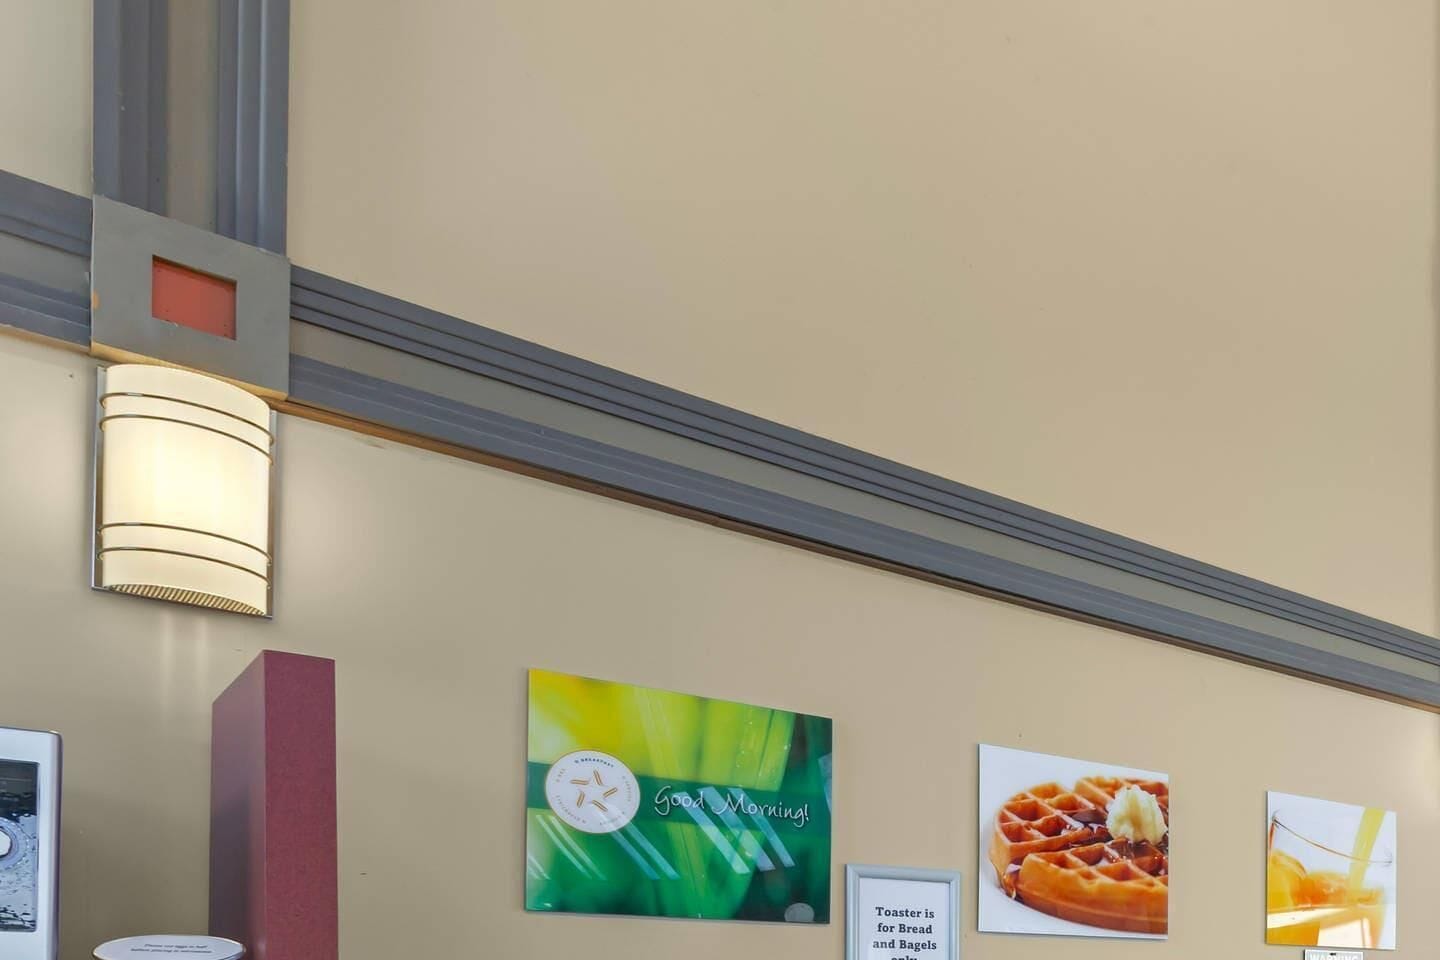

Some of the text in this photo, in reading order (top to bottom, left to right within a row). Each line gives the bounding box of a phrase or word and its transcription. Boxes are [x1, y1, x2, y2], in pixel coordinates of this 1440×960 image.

[654, 785, 705, 816] Good
[711, 793, 810, 828] Morning!
[875, 906, 935, 919] Toaster is
[877, 922, 933, 934] for Bread
[873, 939, 937, 953] and Bagels
